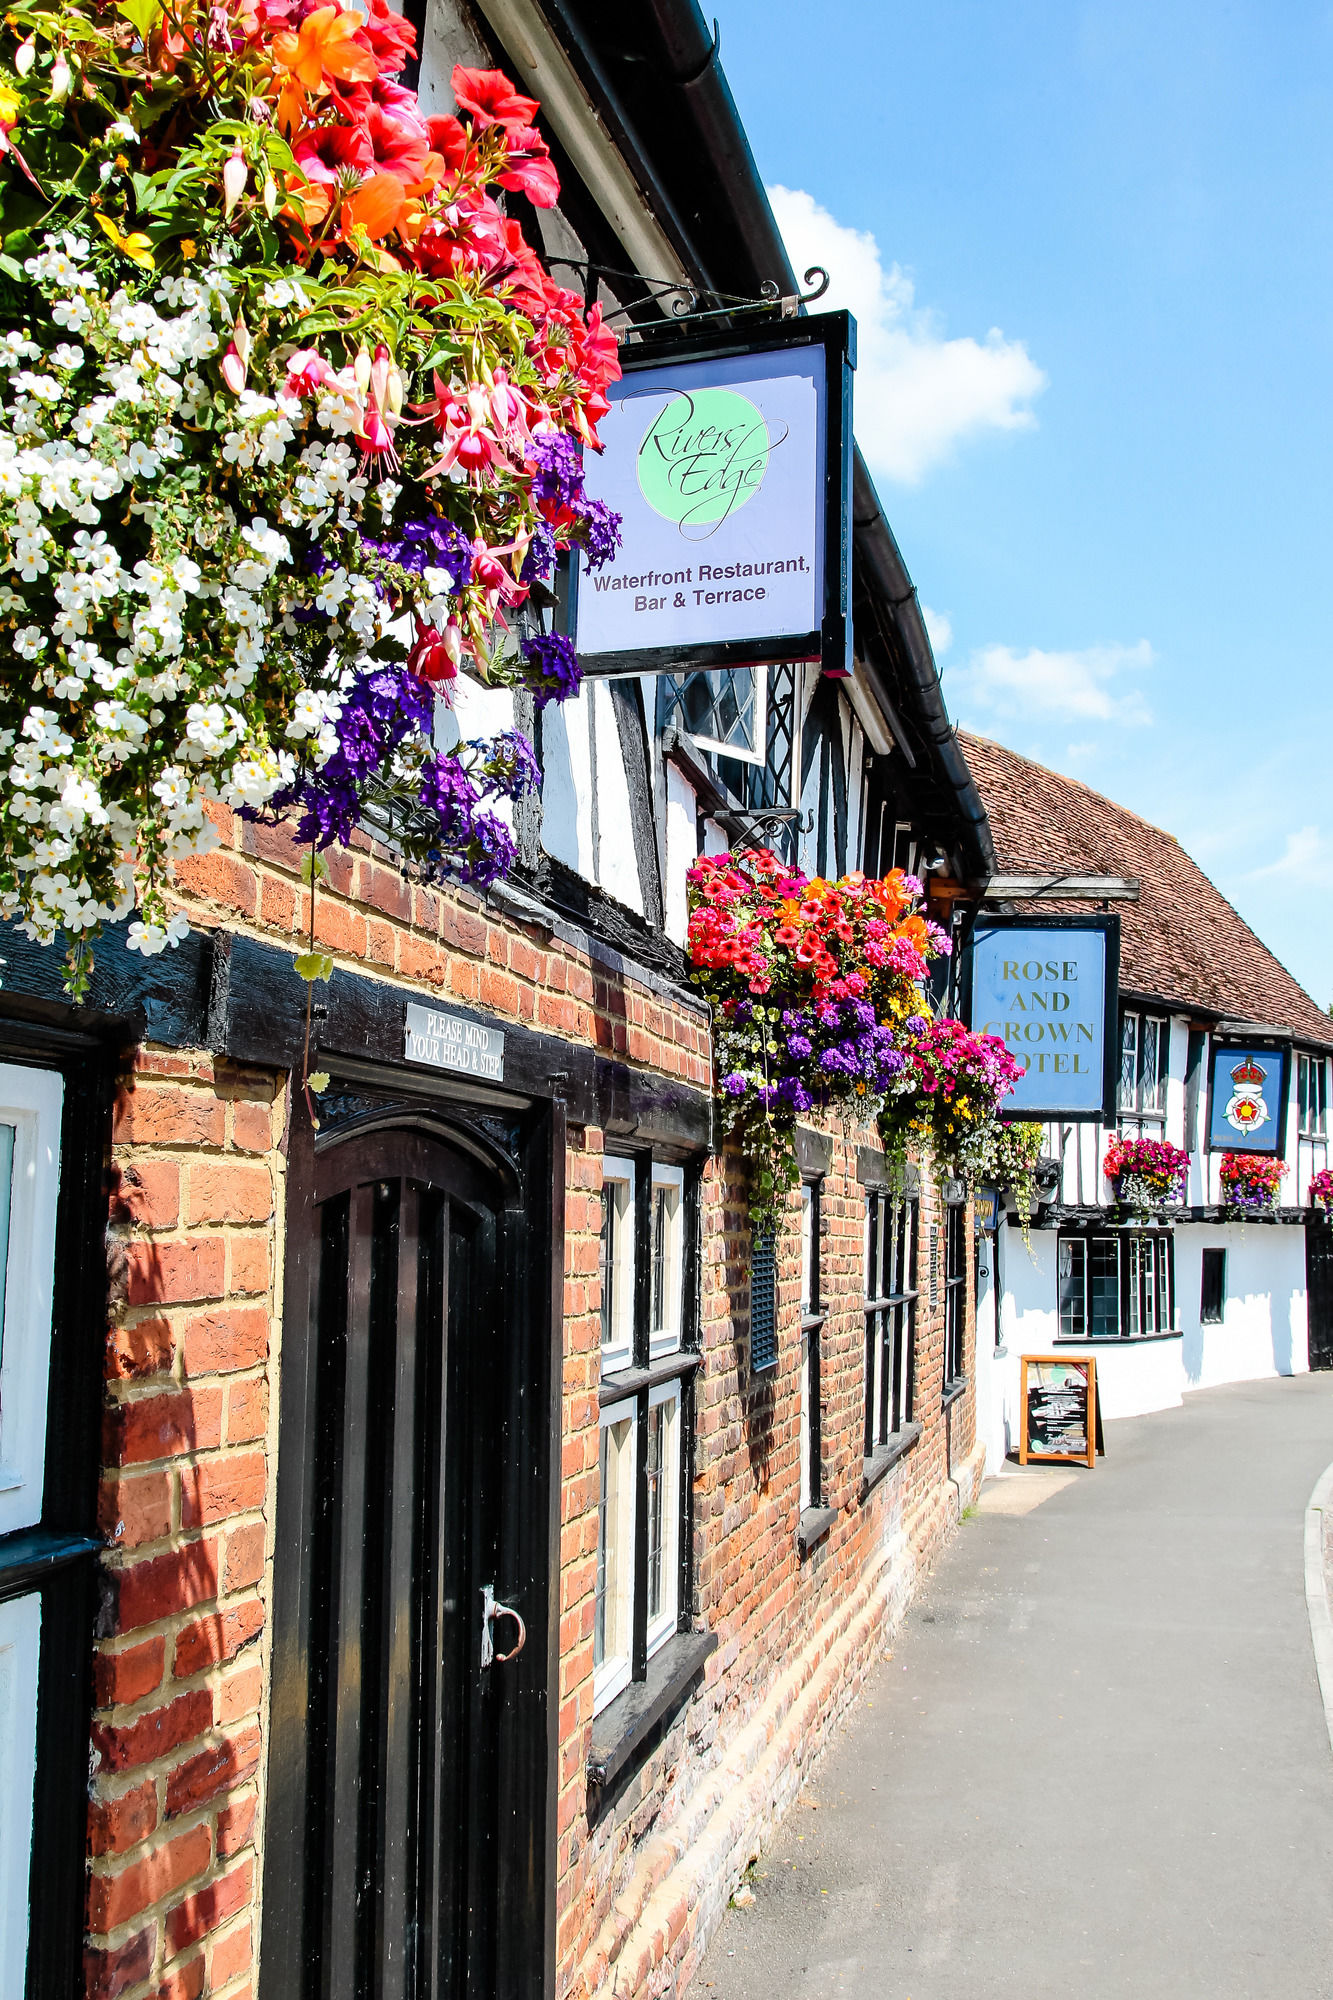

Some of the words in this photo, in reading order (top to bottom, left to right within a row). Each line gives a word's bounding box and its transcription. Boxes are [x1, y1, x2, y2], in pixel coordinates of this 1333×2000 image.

[668, 419, 788, 541] Edge
[593, 567, 693, 592] Waterfront
[699, 555, 811, 582] Restaurant,
[633, 595, 668, 612] Bar
[672, 591, 687, 608] &
[692, 586, 767, 606] Terrace
[1002, 960, 1078, 982] ROSE
[1009, 991, 1070, 1012] AND
[427, 1014, 462, 1042] PLEASE
[465, 1025, 489, 1050] MIND
[411, 1035, 440, 1061] YOUR
[443, 1043, 470, 1068] HEAD
[472, 1051, 478, 1071] &
[481, 1054, 499, 1075] STEP
[1014, 1052, 1090, 1074] OTEL
